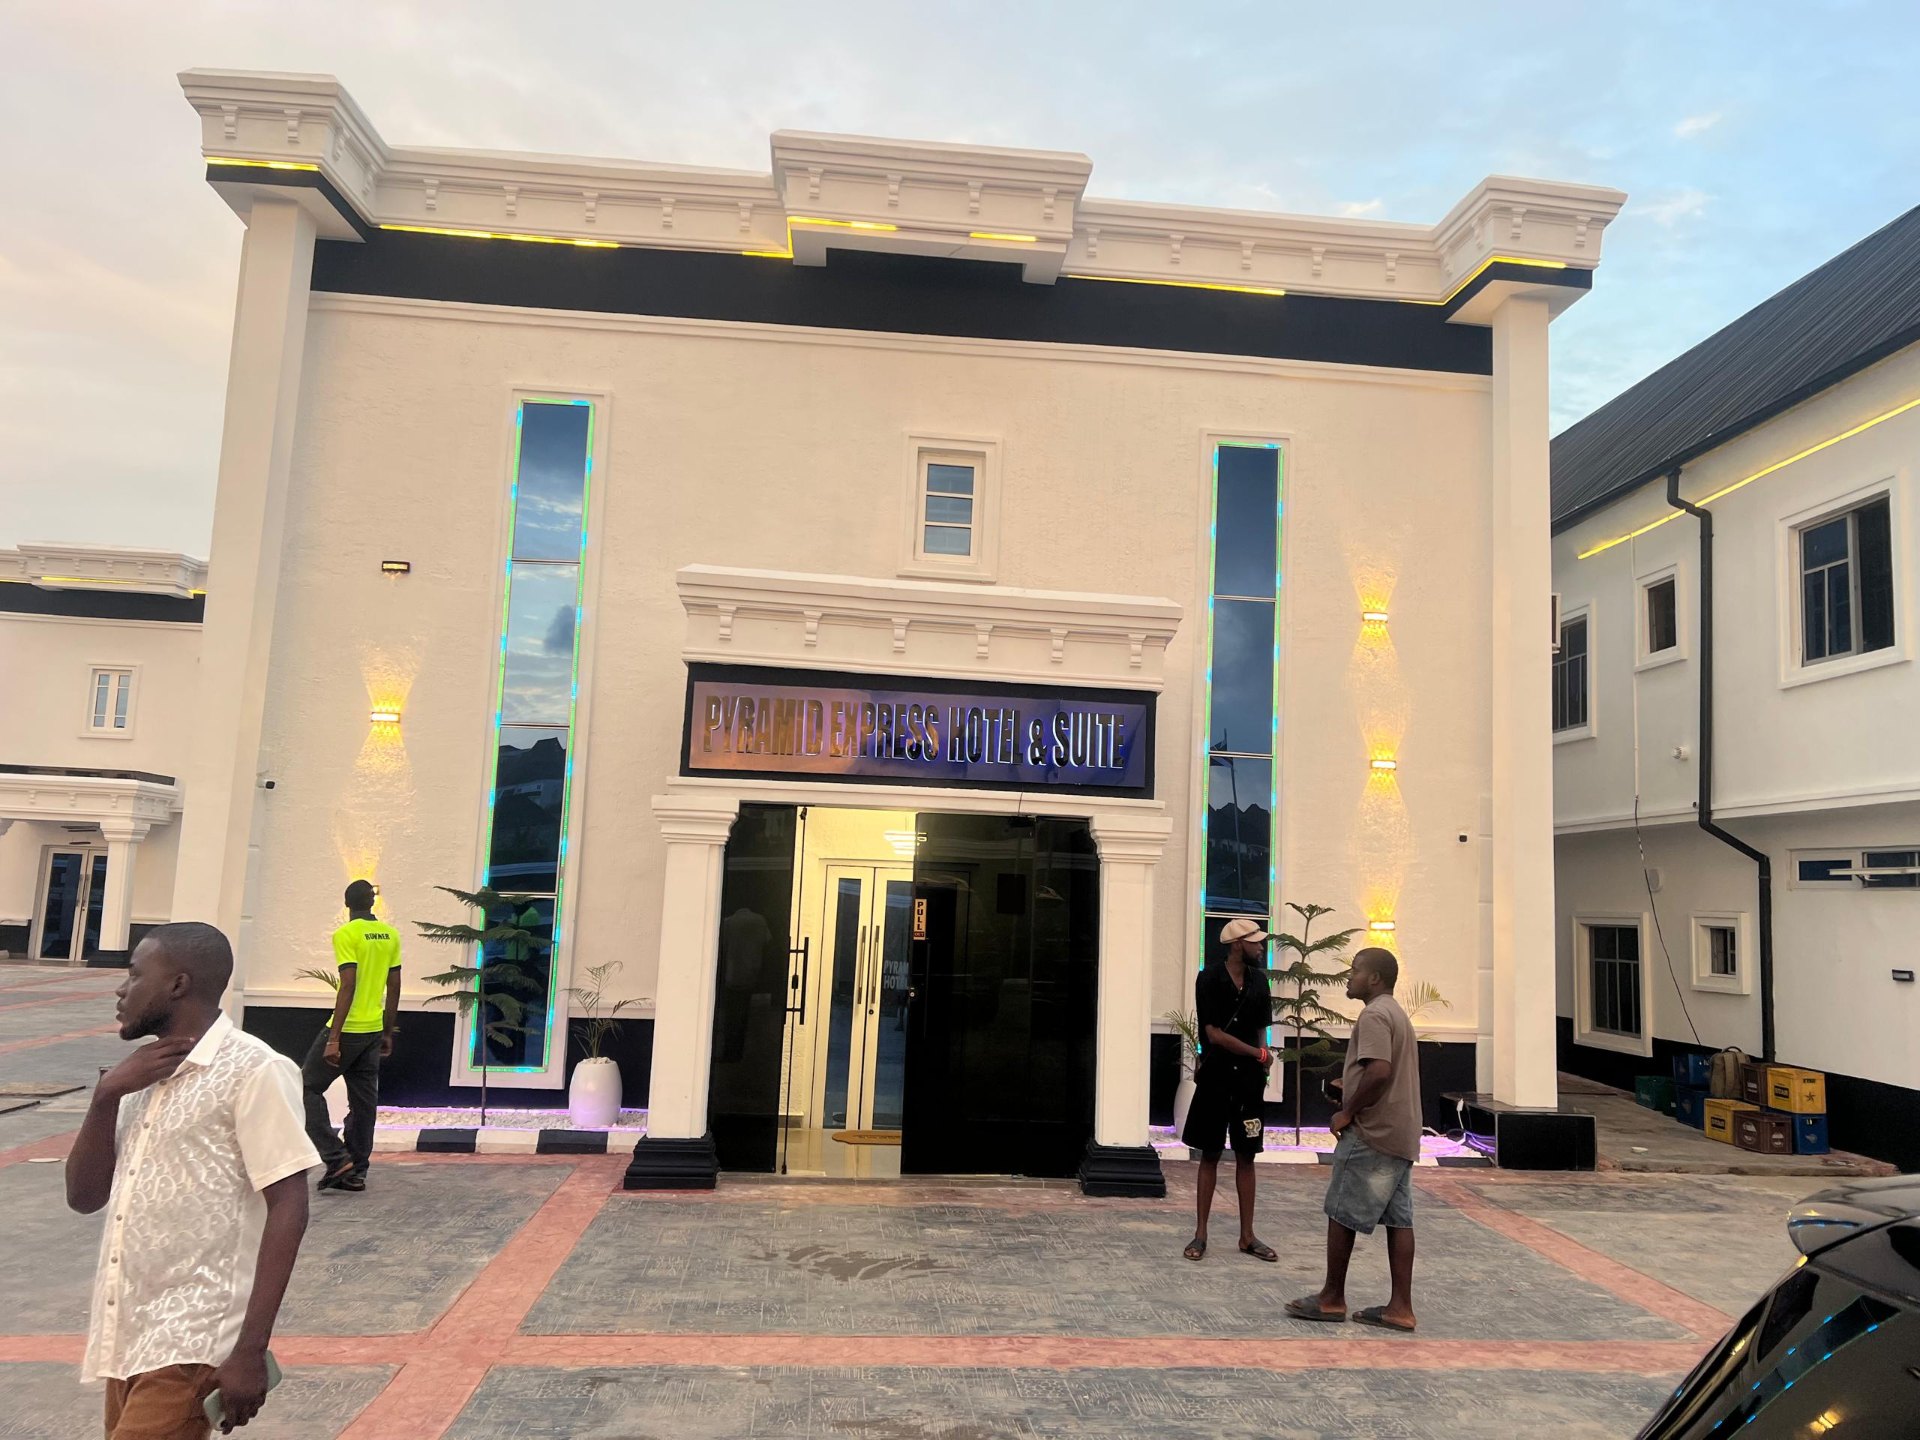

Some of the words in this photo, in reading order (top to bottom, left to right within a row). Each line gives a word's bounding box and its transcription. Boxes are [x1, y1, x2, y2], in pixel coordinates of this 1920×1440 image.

[704, 696, 824, 756] PYRAMID
[830, 701, 939, 762] EXPRESS
[947, 706, 1023, 764] HOTEL
[1028, 718, 1047, 765] &
[1053, 711, 1125, 768] SUITE
